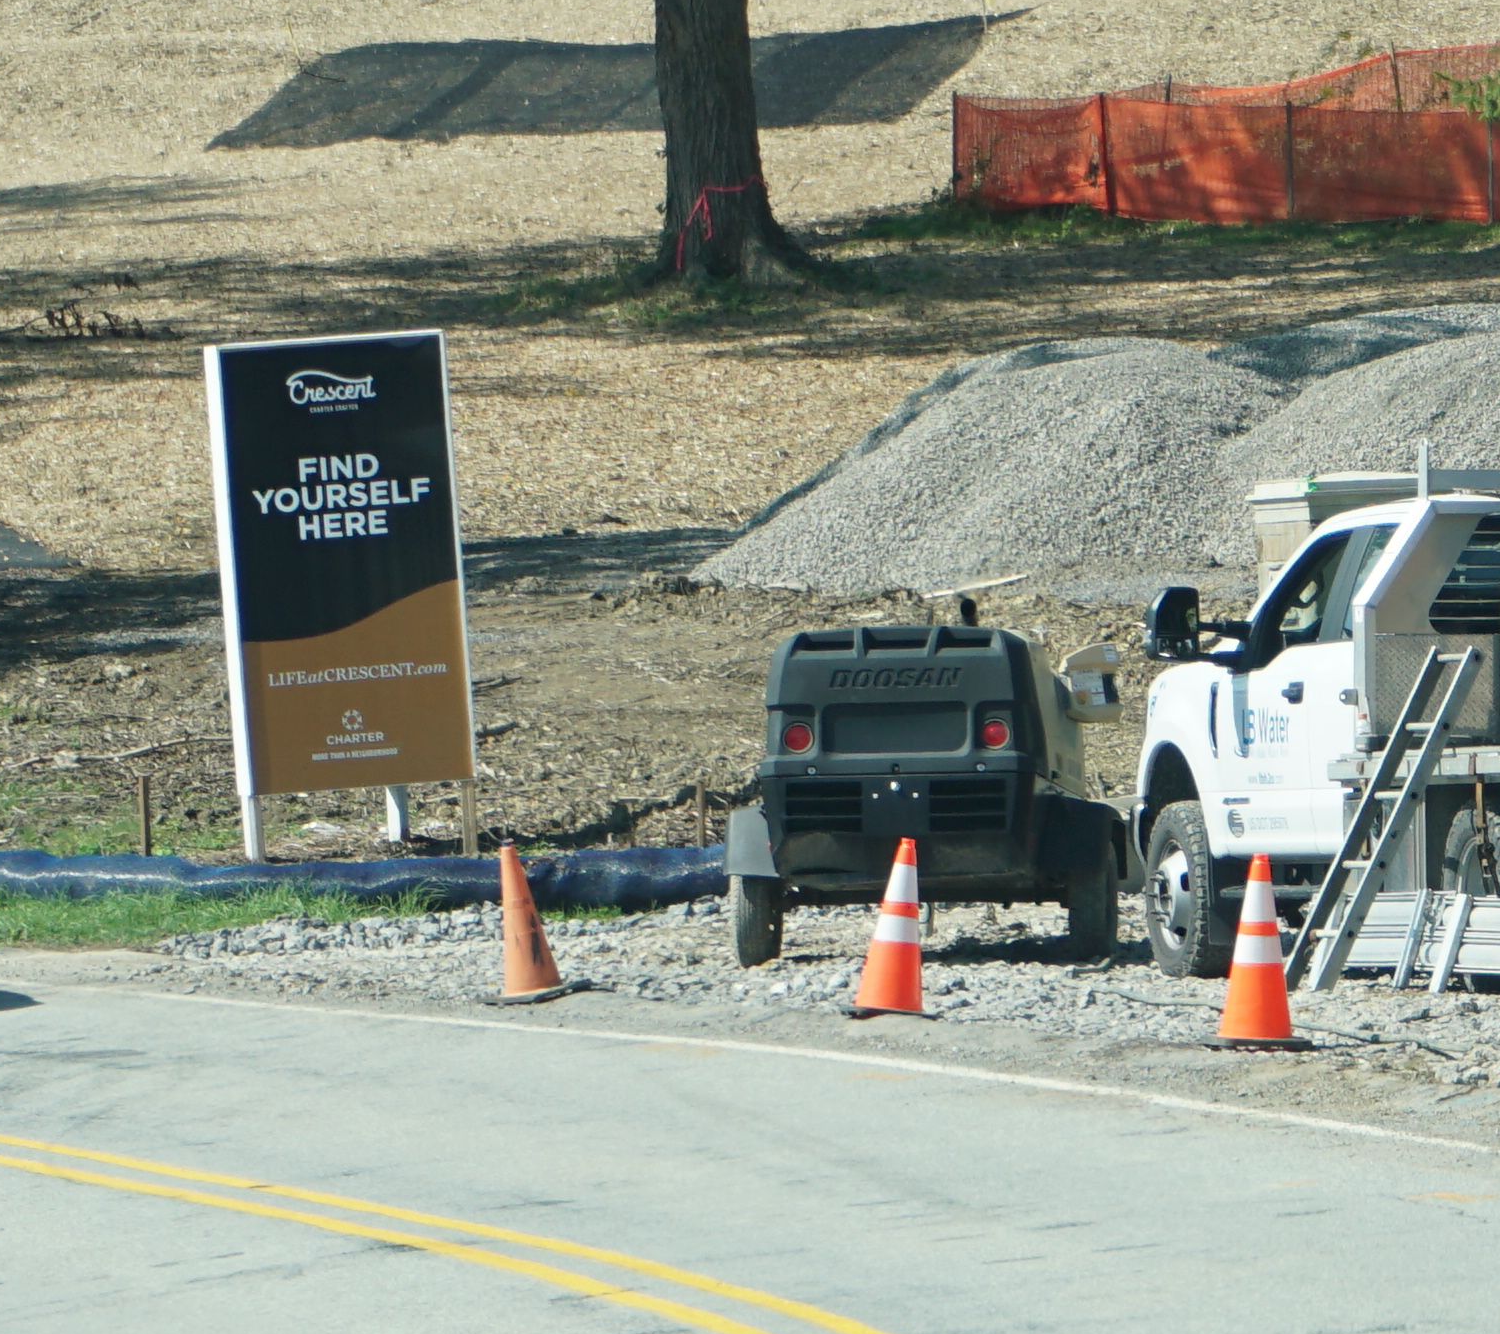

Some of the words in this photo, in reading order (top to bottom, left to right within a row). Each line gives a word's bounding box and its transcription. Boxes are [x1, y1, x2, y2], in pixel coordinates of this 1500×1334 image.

[285, 370, 377, 404] Crescent
[298, 453, 379, 483] FIND
[252, 477, 431, 514] YOURSELF
[298, 509, 389, 540] HERE
[268, 662, 448, 687] LIFEatCRESCENT.com
[829, 667, 962, 689] DOOSAN
[326, 731, 384, 745] CHARTER
[1257, 707, 1290, 744] Water
